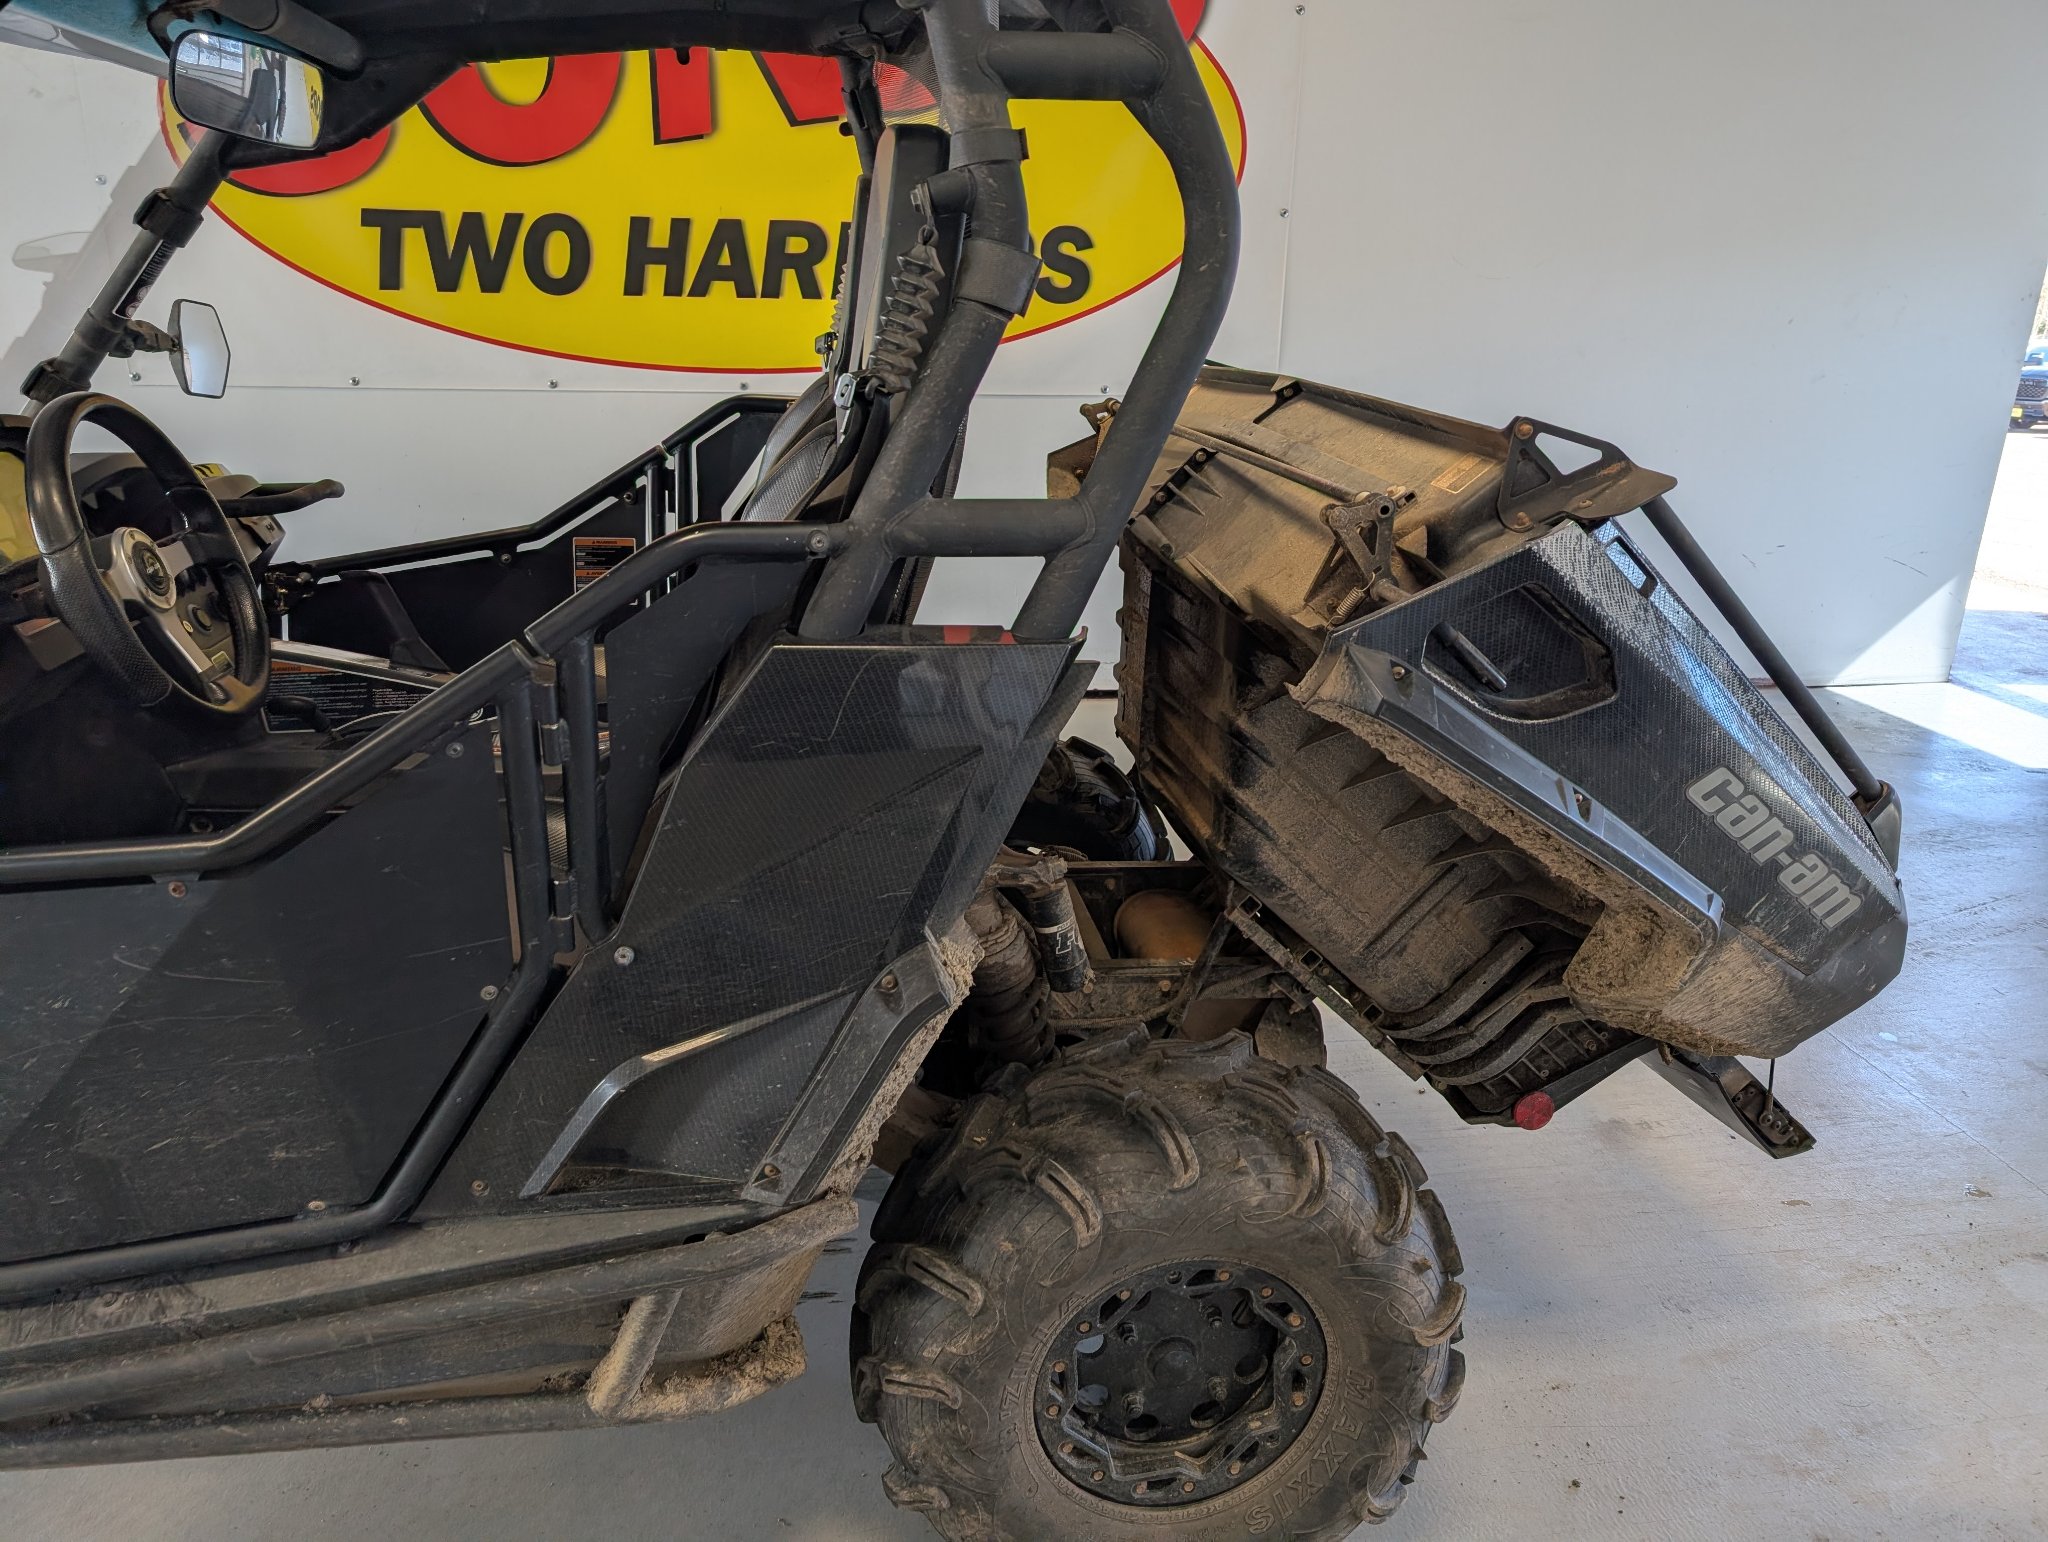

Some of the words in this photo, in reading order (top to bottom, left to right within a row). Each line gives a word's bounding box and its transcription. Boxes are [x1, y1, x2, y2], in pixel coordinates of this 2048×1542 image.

[361, 208, 591, 296] TWO
[623, 216, 1093, 304] HARS
[1687, 766, 1863, 929] can-am
[1245, 1366, 1375, 1535] MAXXIS
